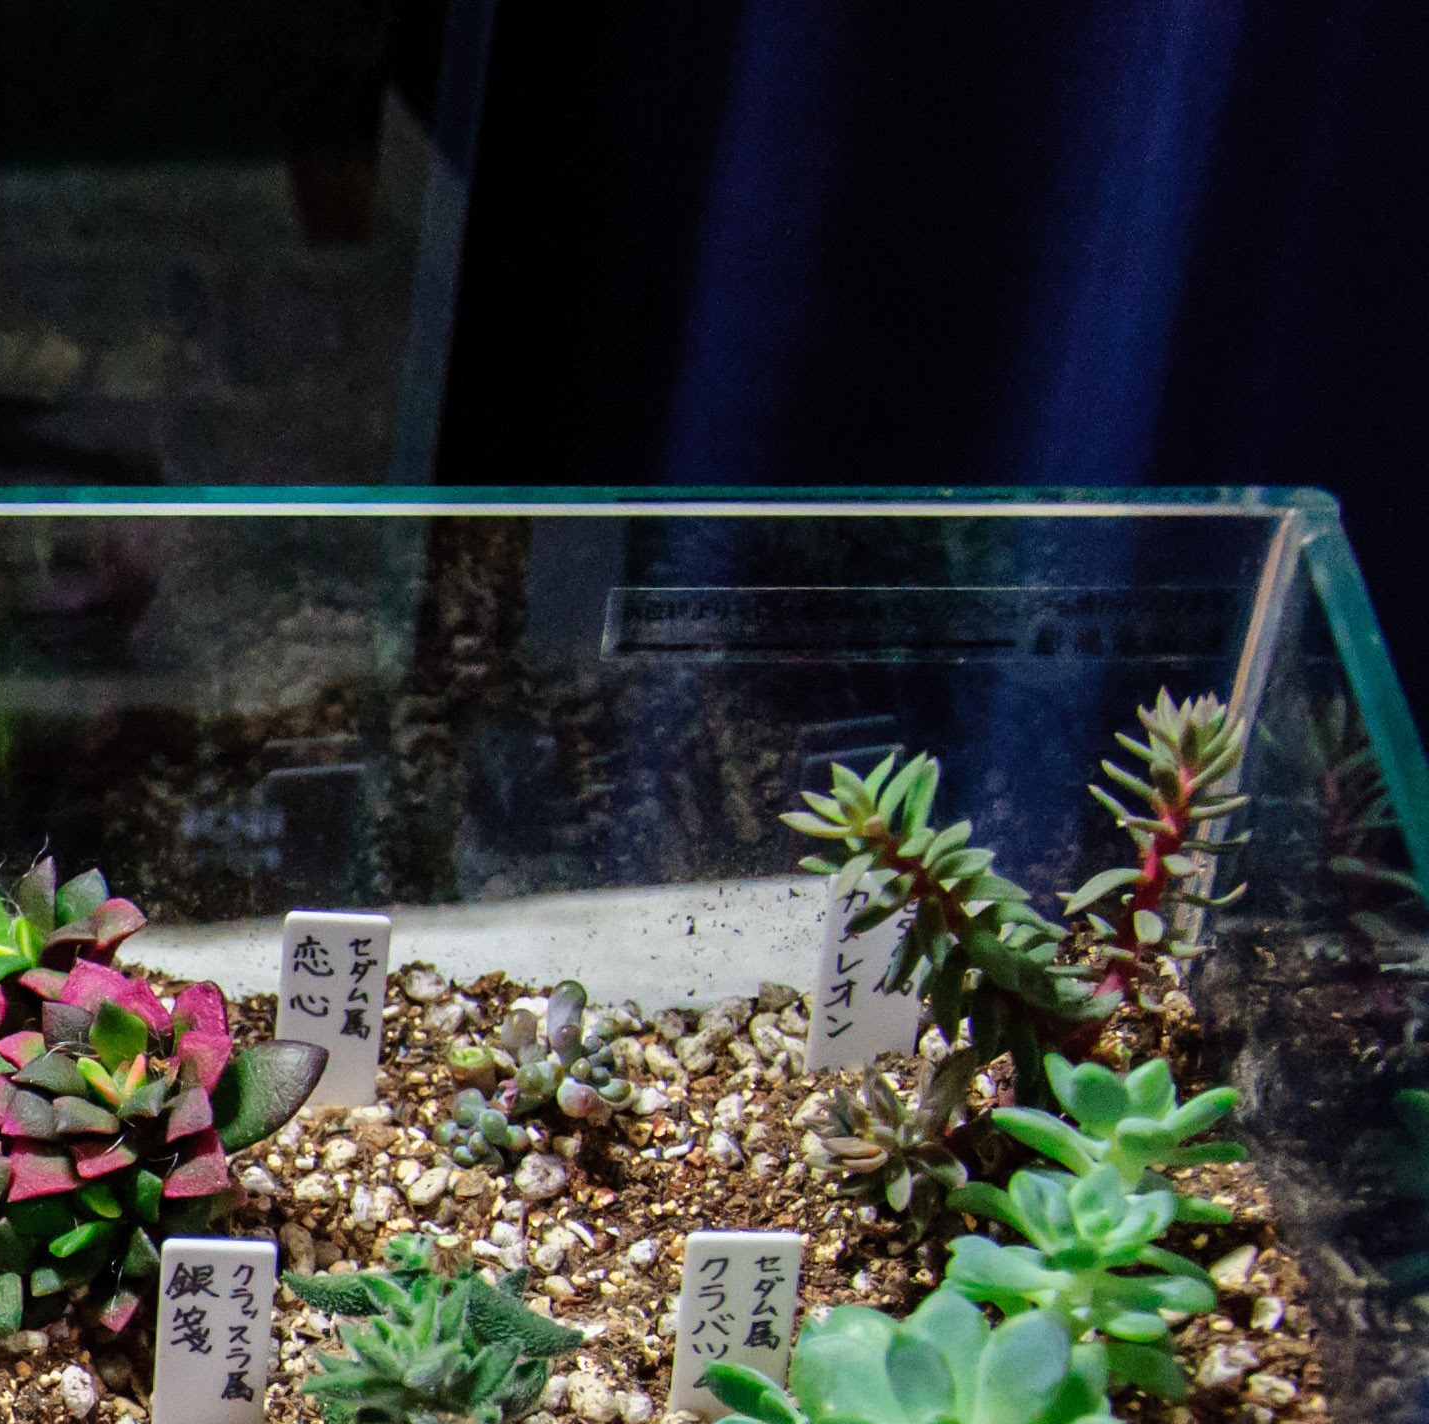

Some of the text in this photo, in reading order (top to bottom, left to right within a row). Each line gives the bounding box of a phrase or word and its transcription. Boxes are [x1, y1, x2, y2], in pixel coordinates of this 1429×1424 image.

[289, 934, 336, 1018] 恋心
[339, 937, 377, 1041] セダム属
[220, 1264, 258, 1403] クラッスラ属
[743, 1255, 786, 1350] セダム属
